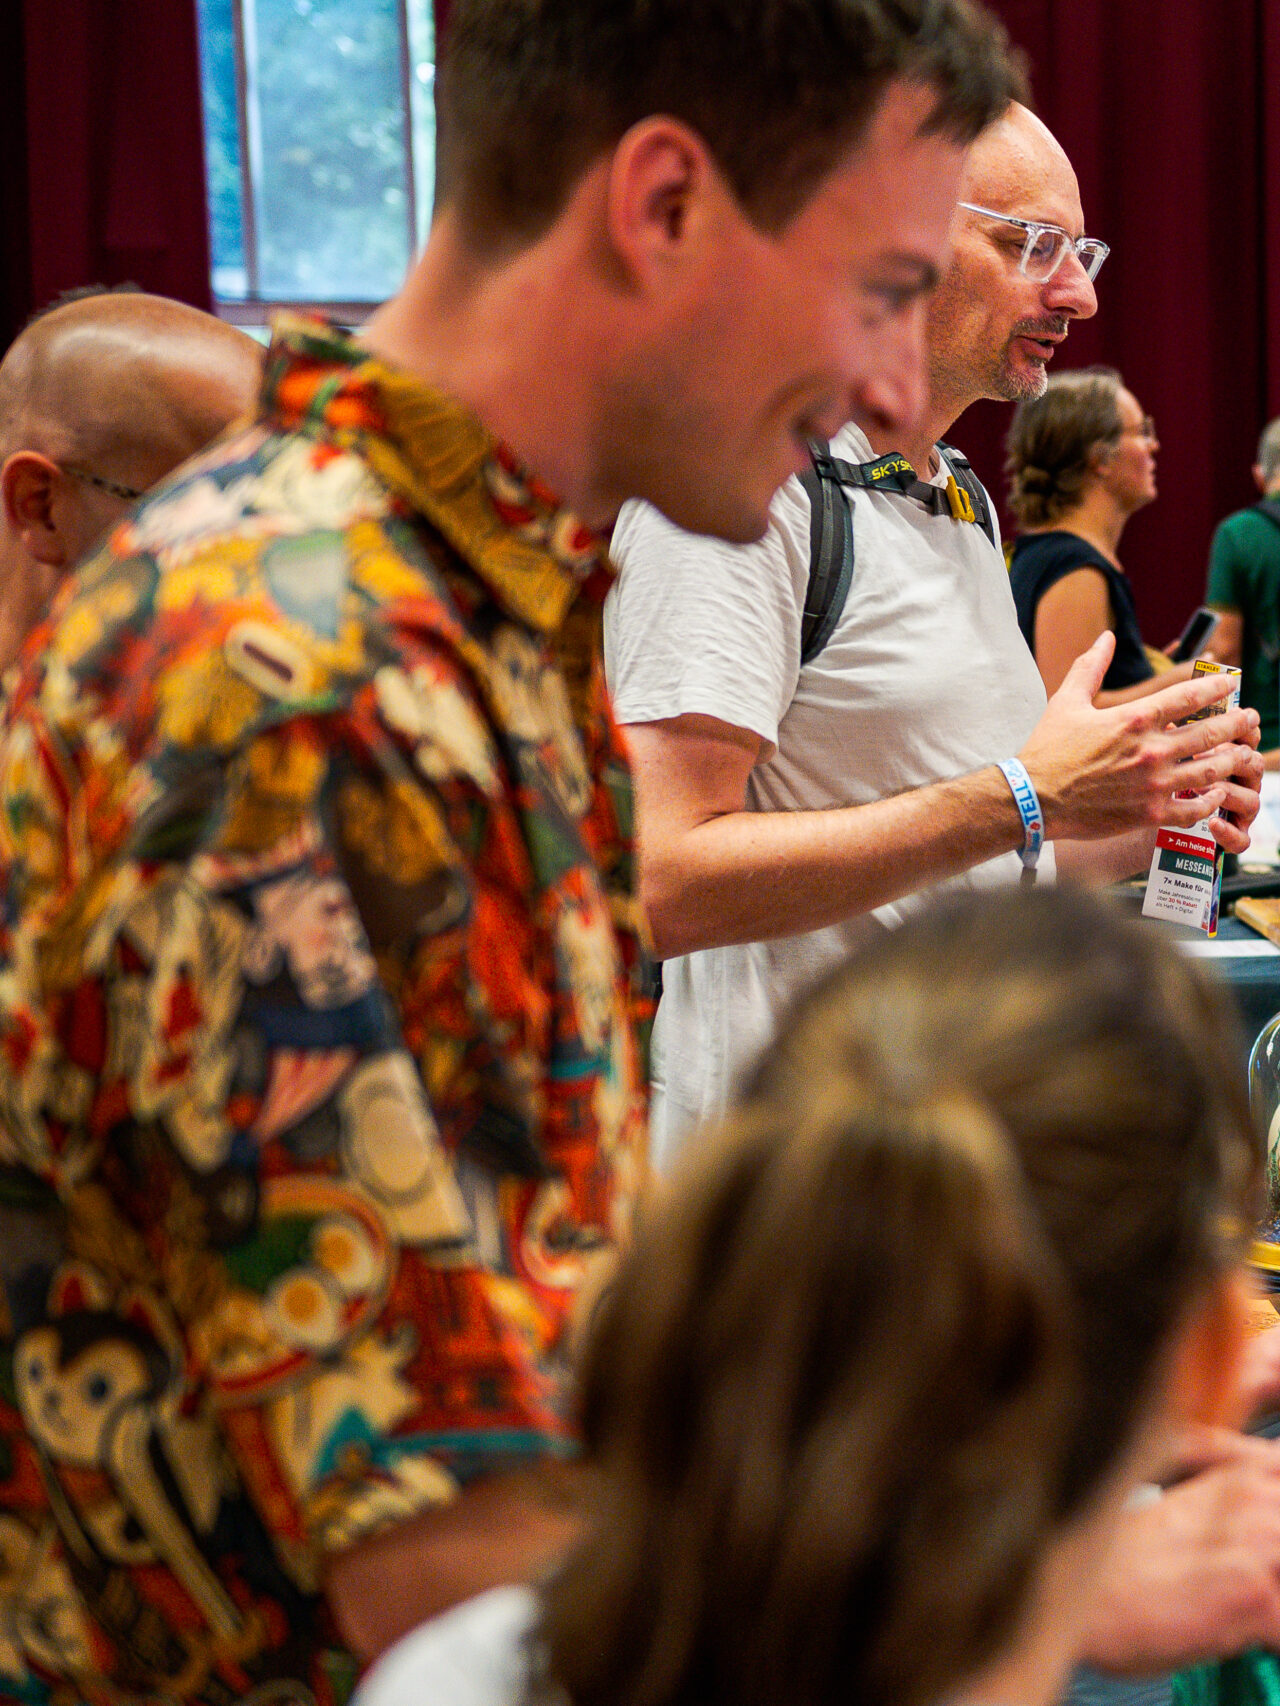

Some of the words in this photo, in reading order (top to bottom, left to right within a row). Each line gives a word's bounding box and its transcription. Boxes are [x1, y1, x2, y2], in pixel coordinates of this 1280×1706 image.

[1015, 780, 1039, 825] TELL
[1175, 839, 1188, 848] Am
[1188, 841, 1206, 853] heise
[1163, 876, 1173, 884] 7x
[1174, 879, 1194, 890] Make
[1194, 884, 1204, 893] für
